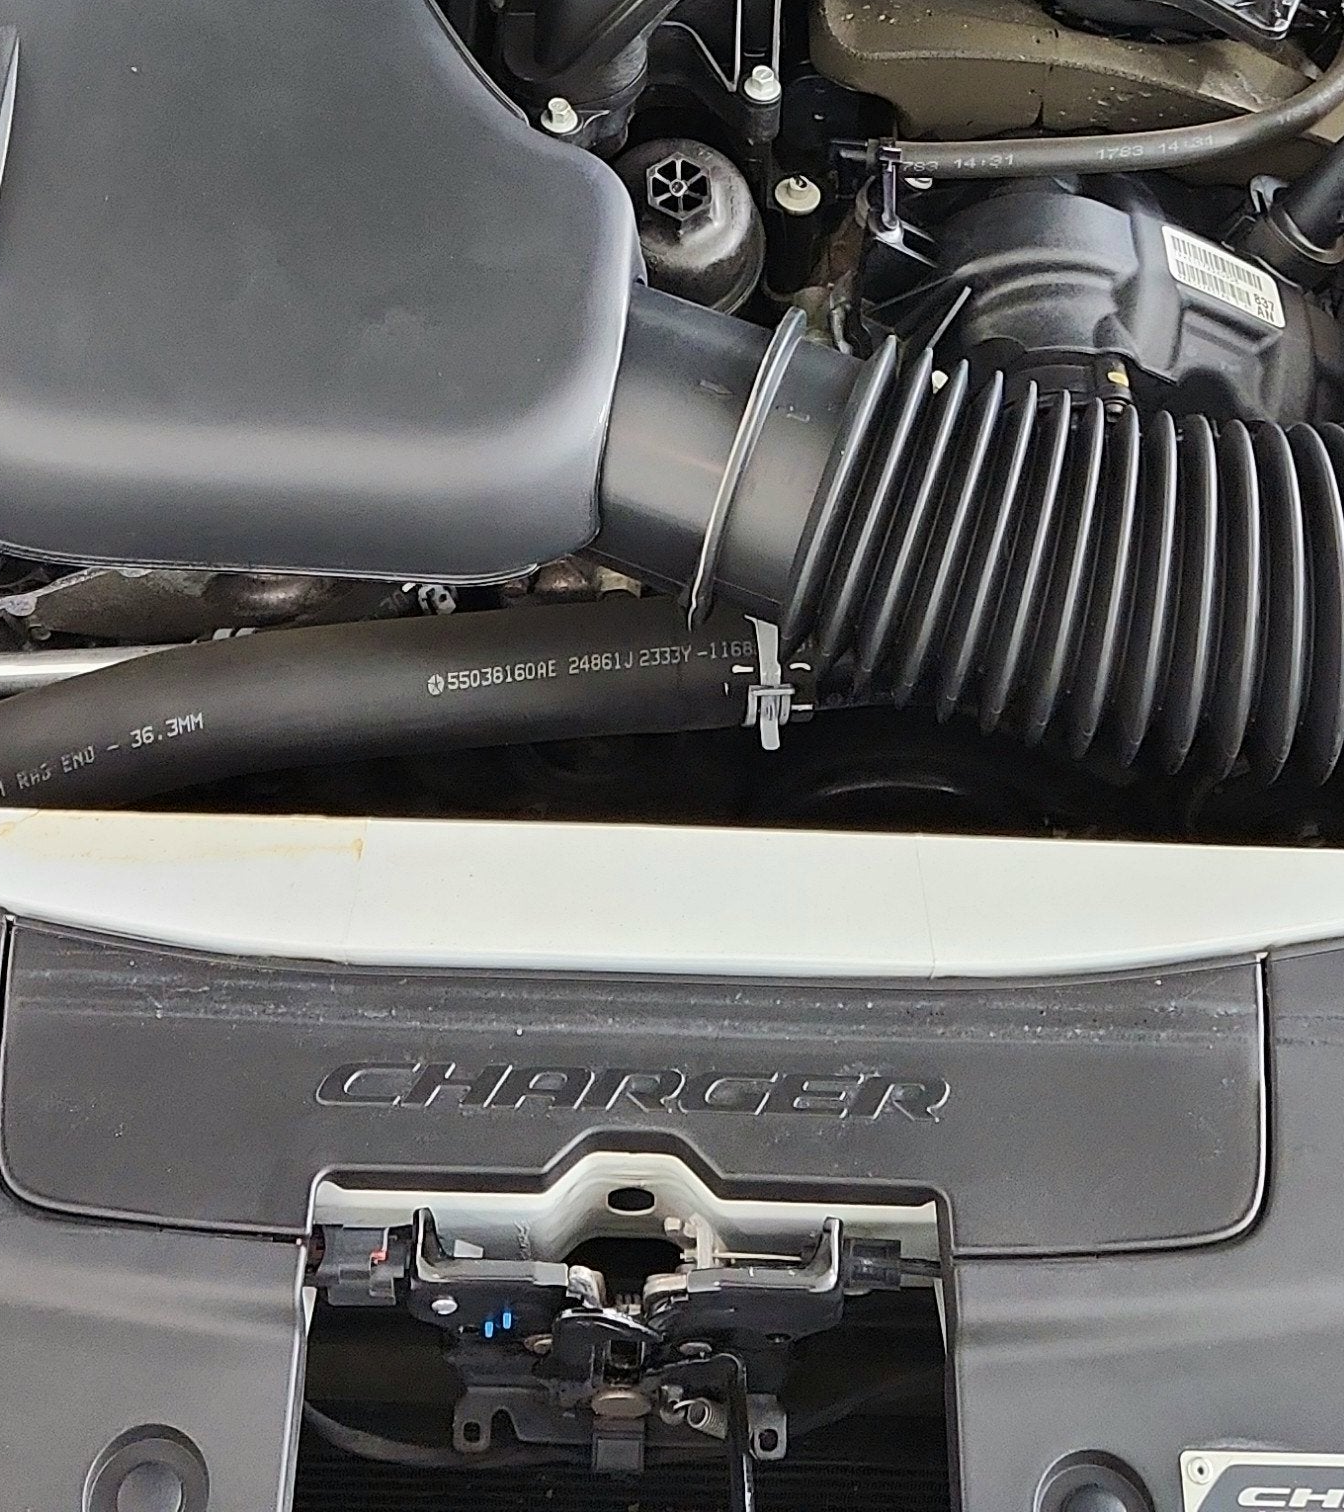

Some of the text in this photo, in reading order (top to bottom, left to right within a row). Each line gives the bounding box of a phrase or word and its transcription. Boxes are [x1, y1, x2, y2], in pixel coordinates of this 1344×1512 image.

[1253, 293, 1275, 313] 837
[446, 659, 557, 691] 55038160AE
[567, 652, 634, 676] 24861J
[638, 644, 692, 667] 2333Y
[129, 711, 204, 749] 36.3MM
[316, 1061, 951, 1123] CHARGER
